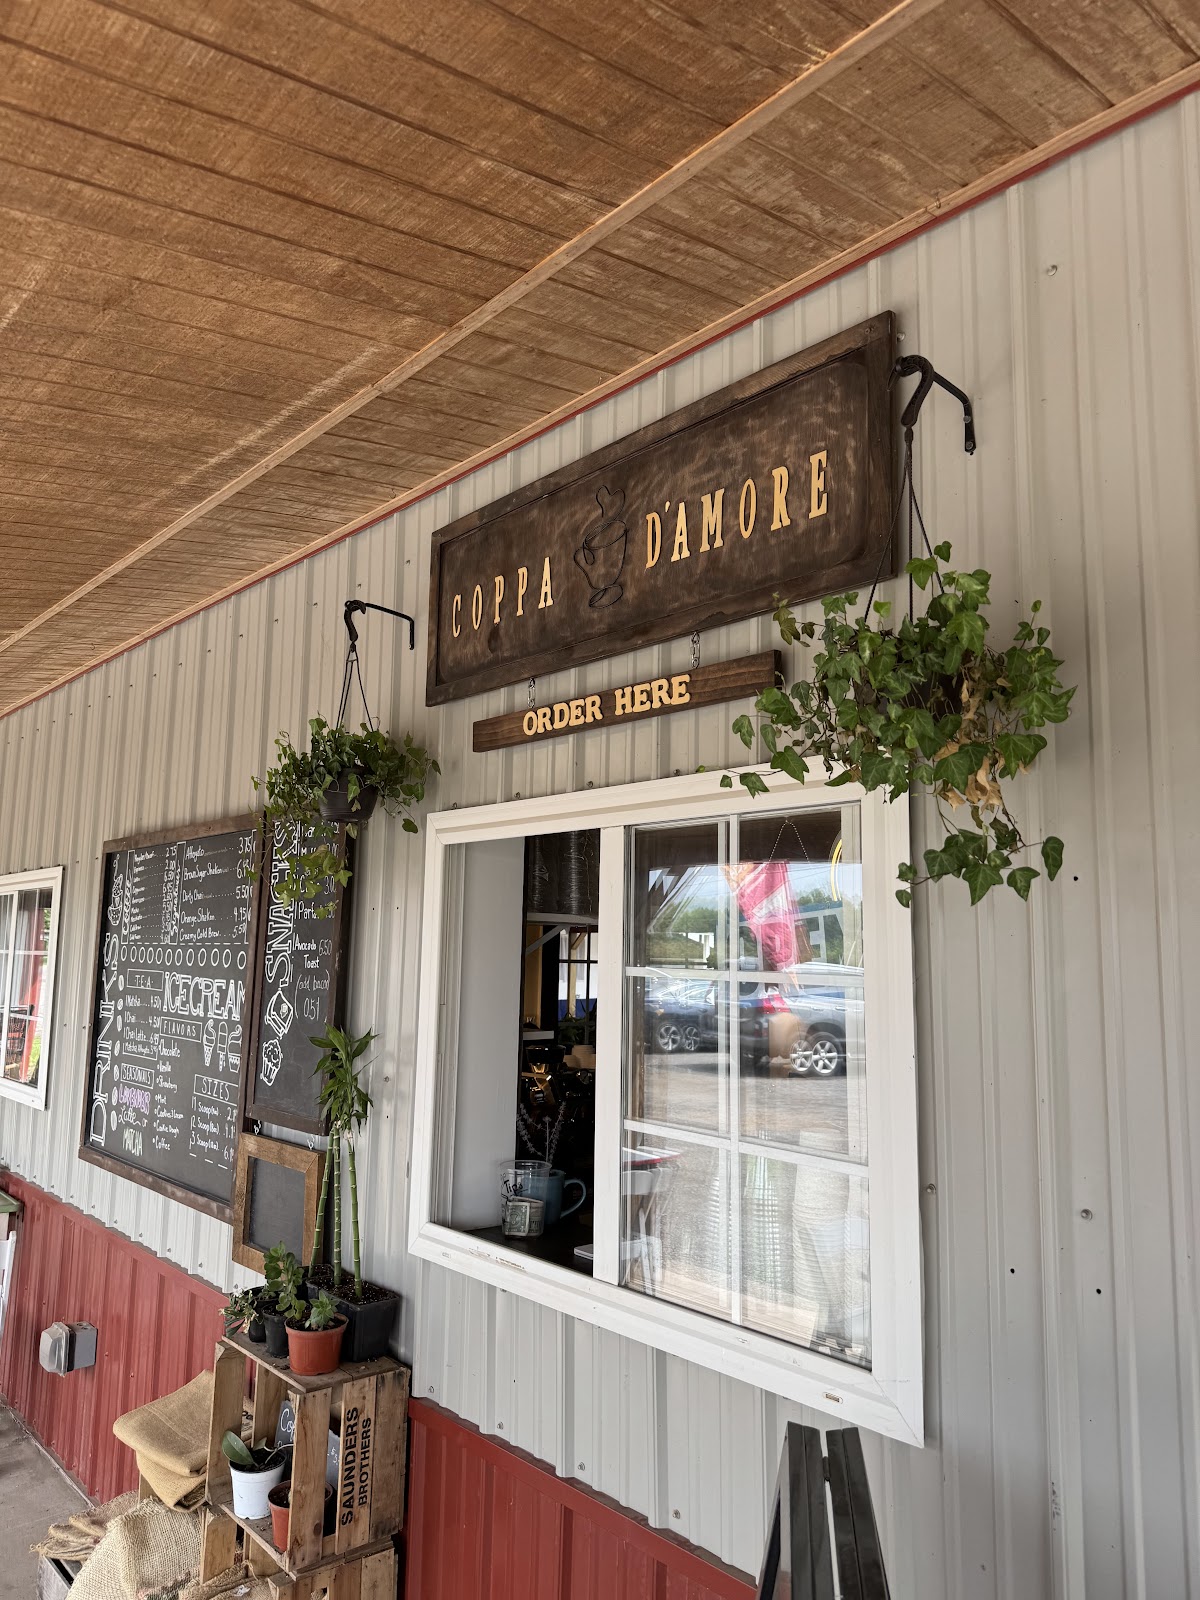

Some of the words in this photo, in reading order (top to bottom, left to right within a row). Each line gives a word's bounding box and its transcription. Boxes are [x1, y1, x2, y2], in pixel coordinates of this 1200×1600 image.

[452, 556, 554, 638] COPPA
[523, 694, 603, 736] ORDER
[614, 674, 691, 716] HERE
[183, 889, 193, 904] Dirty
[180, 911, 198, 927] Orange
[179, 928, 197, 942] Creamy
[197, 927, 207, 939] Cold
[294, 933, 317, 951] Avocado
[303, 954, 320, 969] Toast
[127, 1011, 136, 1023] Chai
[126, 1027, 135, 1040] Chai
[136, 1028, 147, 1042] Latte
[163, 1021, 197, 1037] FLAVORS
[90, 932, 119, 1147] DRINKS
[160, 1039, 180, 1058] Chocolate
[201, 1077, 230, 1101] SIZES
[118, 1105, 140, 1126] Latte
[198, 1101, 210, 1119] Scoop
[197, 1117, 210, 1135] Scoop
[123, 1127, 143, 1156] MATCHA
[155, 1135, 171, 1150] Coffee
[196, 1134, 209, 1152] Scoop
[503, 1179, 524, 1197] Tips
[341, 1406, 359, 1526] SAUNDERS
[358, 1417, 372, 1507] BROTHERS
